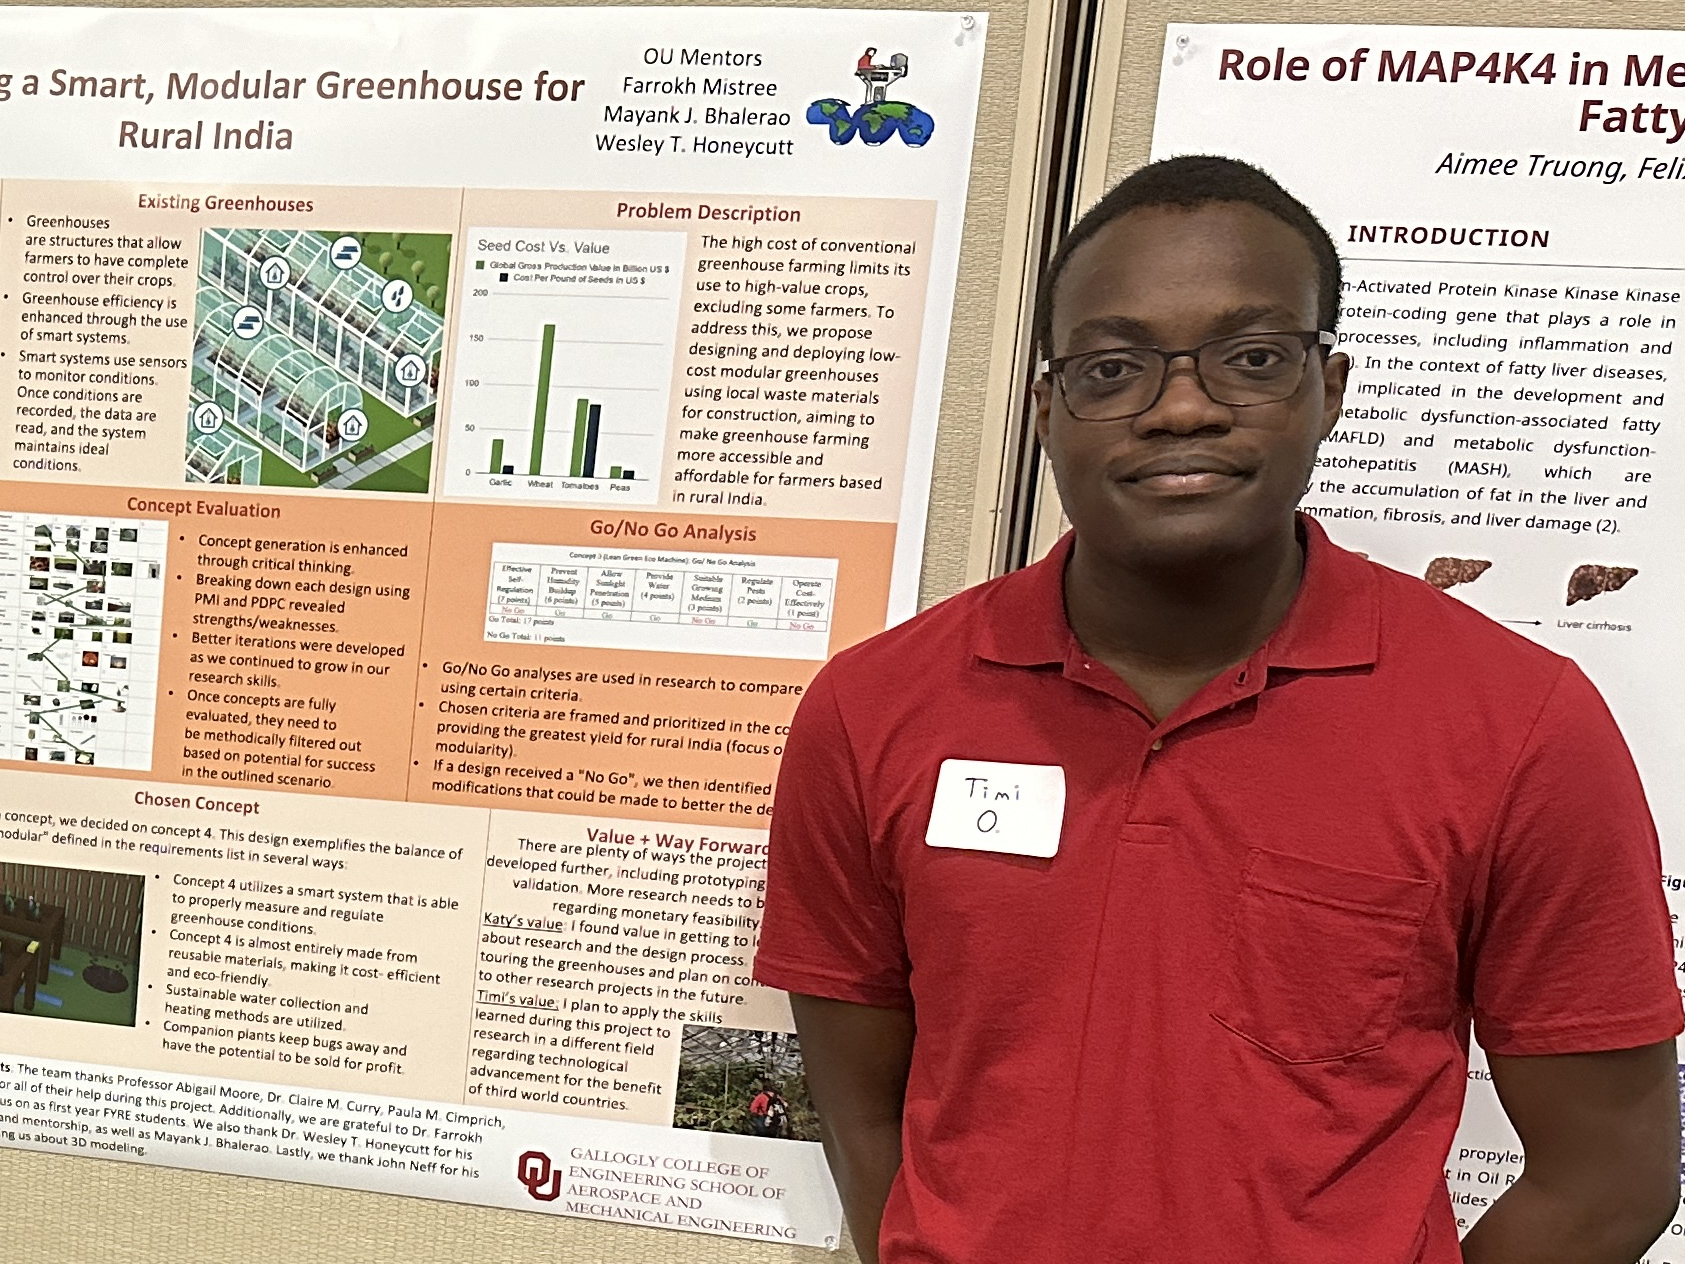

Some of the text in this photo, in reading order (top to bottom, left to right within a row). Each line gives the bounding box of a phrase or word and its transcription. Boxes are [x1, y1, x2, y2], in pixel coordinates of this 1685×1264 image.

[643, 47, 761, 66] OU Mentors
[1218, 47, 1685, 87] Role of MAP4K4 in Me
[21, 74, 38, 95] a
[49, 68, 154, 105] Smart,
[166, 69, 306, 99] Modular
[316, 69, 522, 101] Greenhouse
[533, 70, 585, 101] for
[623, 76, 777, 96] Farrokh Mistree
[604, 105, 790, 126] Mayank J. Bhalerao
[1579, 99, 1685, 144] Fatty
[118, 119, 292, 150] Rural India
[595, 134, 794, 158] Wesley T. Honeycutt
[1434, 152, 1685, 184] Aimee Truong, Feli
[138, 193, 313, 213] Existing Greenhouses
[616, 202, 800, 225] Problem Description
[477, 238, 511, 251] Seed
[515, 239, 545, 252] Cost
[574, 241, 610, 254] Value
[701, 234, 915, 254] The high cost of conventional
[1347, 224, 1549, 247] INTRODUCTION
[1438, 282, 1680, 302] Protein Kinase Kinase Kinase
[126, 497, 280, 518] Concept Evaluation
[590, 519, 756, 544] Go/No Go Analysis
[965, 777, 1020, 801] Timi
[134, 790, 260, 816] Chosen Concept
[586, 827, 635, 845] Value
[639, 834, 650, 845] +
[655, 833, 694, 853] Way
[570, 1147, 769, 1179] GALLOGLY COLLEGE OF
[517, 1151, 562, 1202] OU
[568, 1165, 785, 1199] ENGINEERING SCHOOL OF
[566, 1183, 702, 1209] AEROSPACE AND
[566, 1201, 796, 1239] MECHANICAL ENGINEERING
